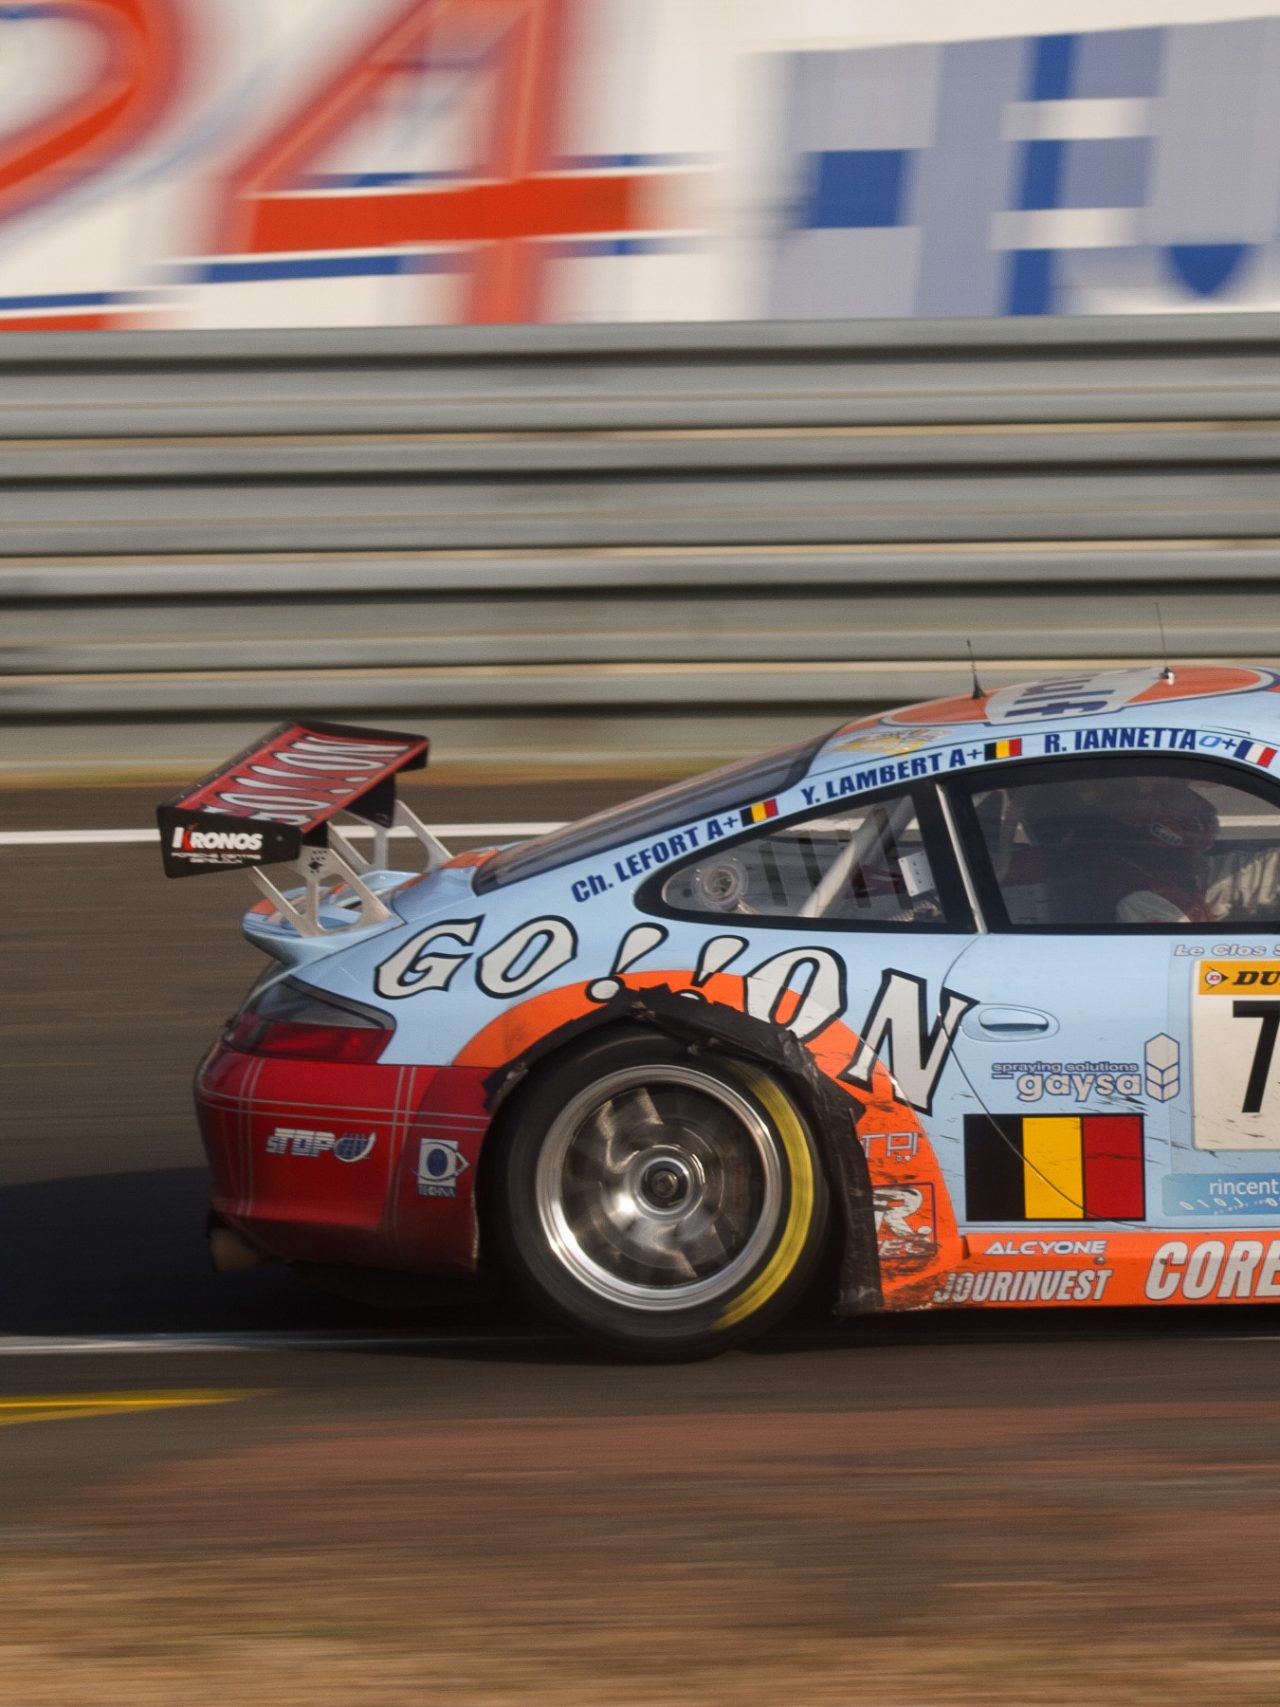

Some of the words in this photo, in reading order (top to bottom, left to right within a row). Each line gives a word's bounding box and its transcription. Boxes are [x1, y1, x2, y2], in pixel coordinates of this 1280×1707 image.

[1044, 734, 1067, 753] R.
[1074, 728, 1197, 750] IANNETTA
[801, 786, 821, 805] Y.
[826, 753, 942, 798] LAMBERT
[948, 749, 983, 768] A+
[172, 824, 263, 850] KRONOS
[571, 872, 613, 903] Ch.
[614, 827, 699, 882] LEFORT
[707, 816, 738, 840] A+
[1174, 944, 1204, 957] Le
[1212, 943, 1265, 957] Clos
[992, 1061, 1063, 1073] spraying
[1065, 1061, 1139, 1073] solutions
[1017, 1073, 1142, 1102] gaysa
[1210, 1178, 1280, 1195] rincent
[984, 1240, 1107, 1255] ALCYONE
